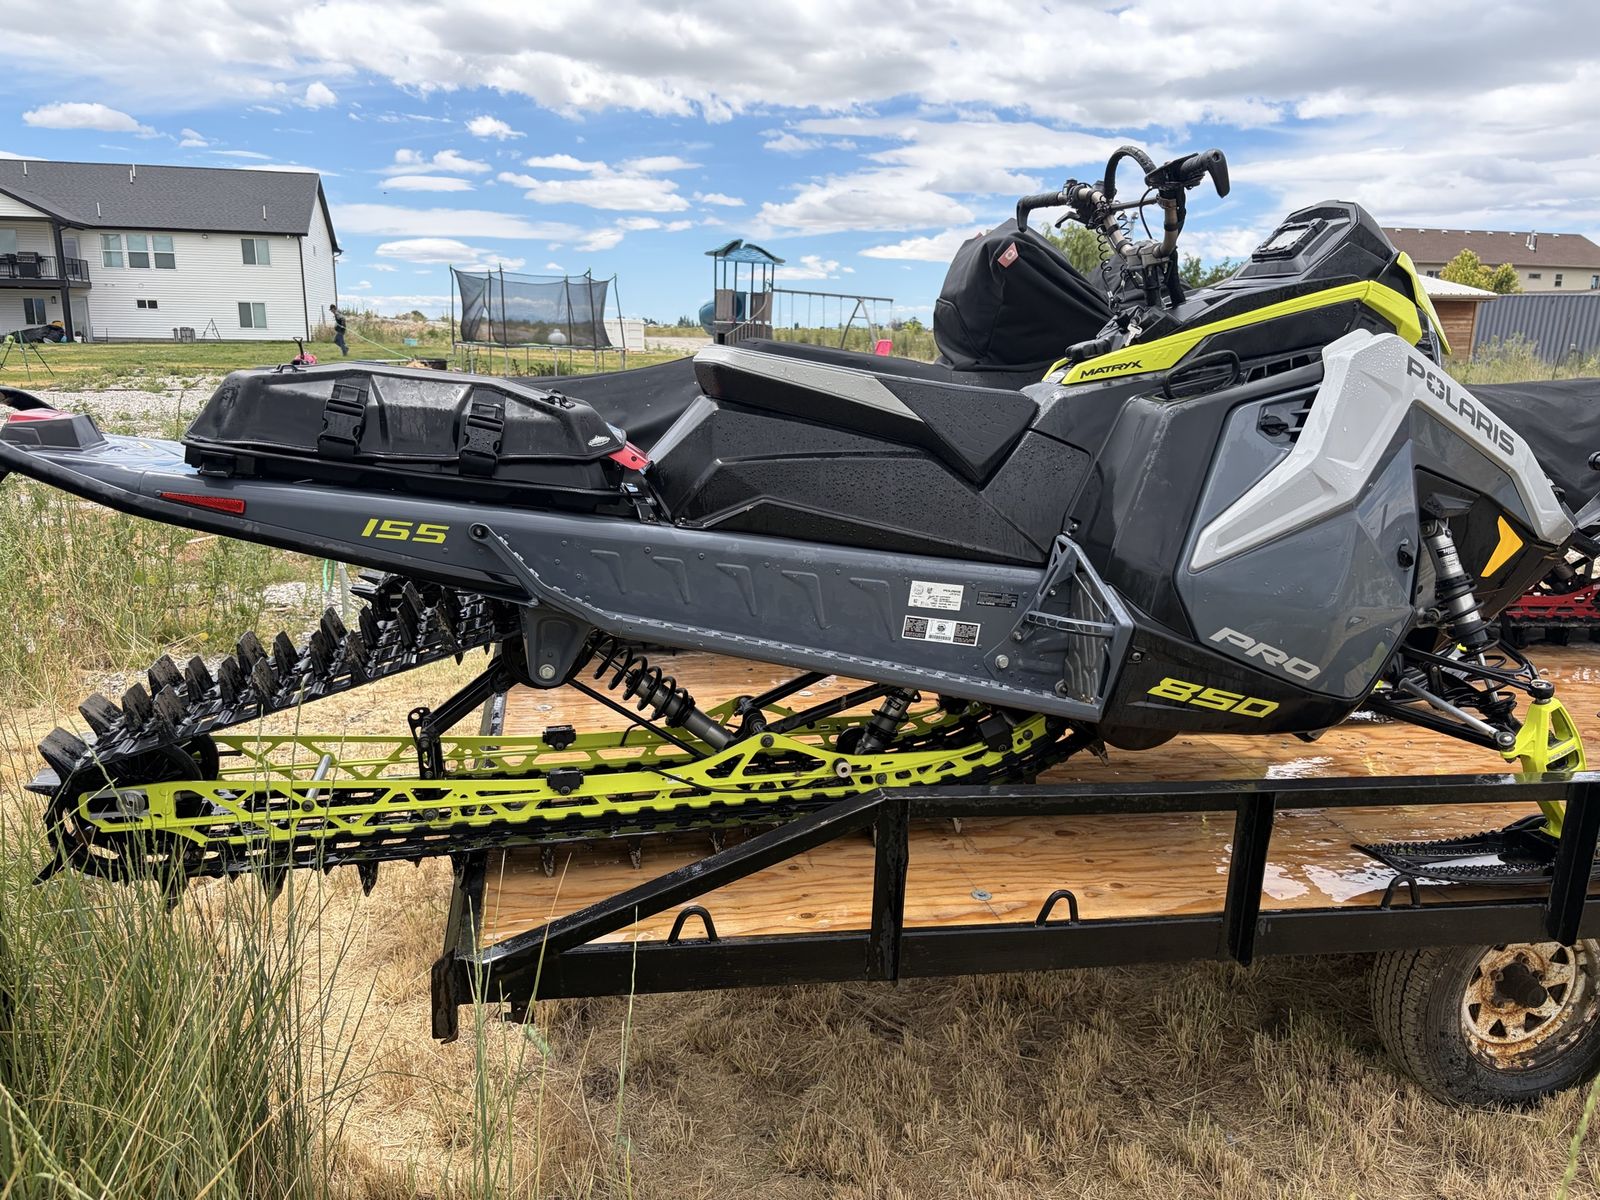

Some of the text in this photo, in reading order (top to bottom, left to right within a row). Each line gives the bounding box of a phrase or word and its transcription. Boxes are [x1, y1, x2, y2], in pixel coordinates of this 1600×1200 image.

[1080, 360, 1143, 379] MATRYX
[1407, 355, 1514, 456] POLARIS
[361, 518, 450, 544] 155
[1209, 627, 1321, 681] PRO
[1147, 677, 1280, 718] 850
